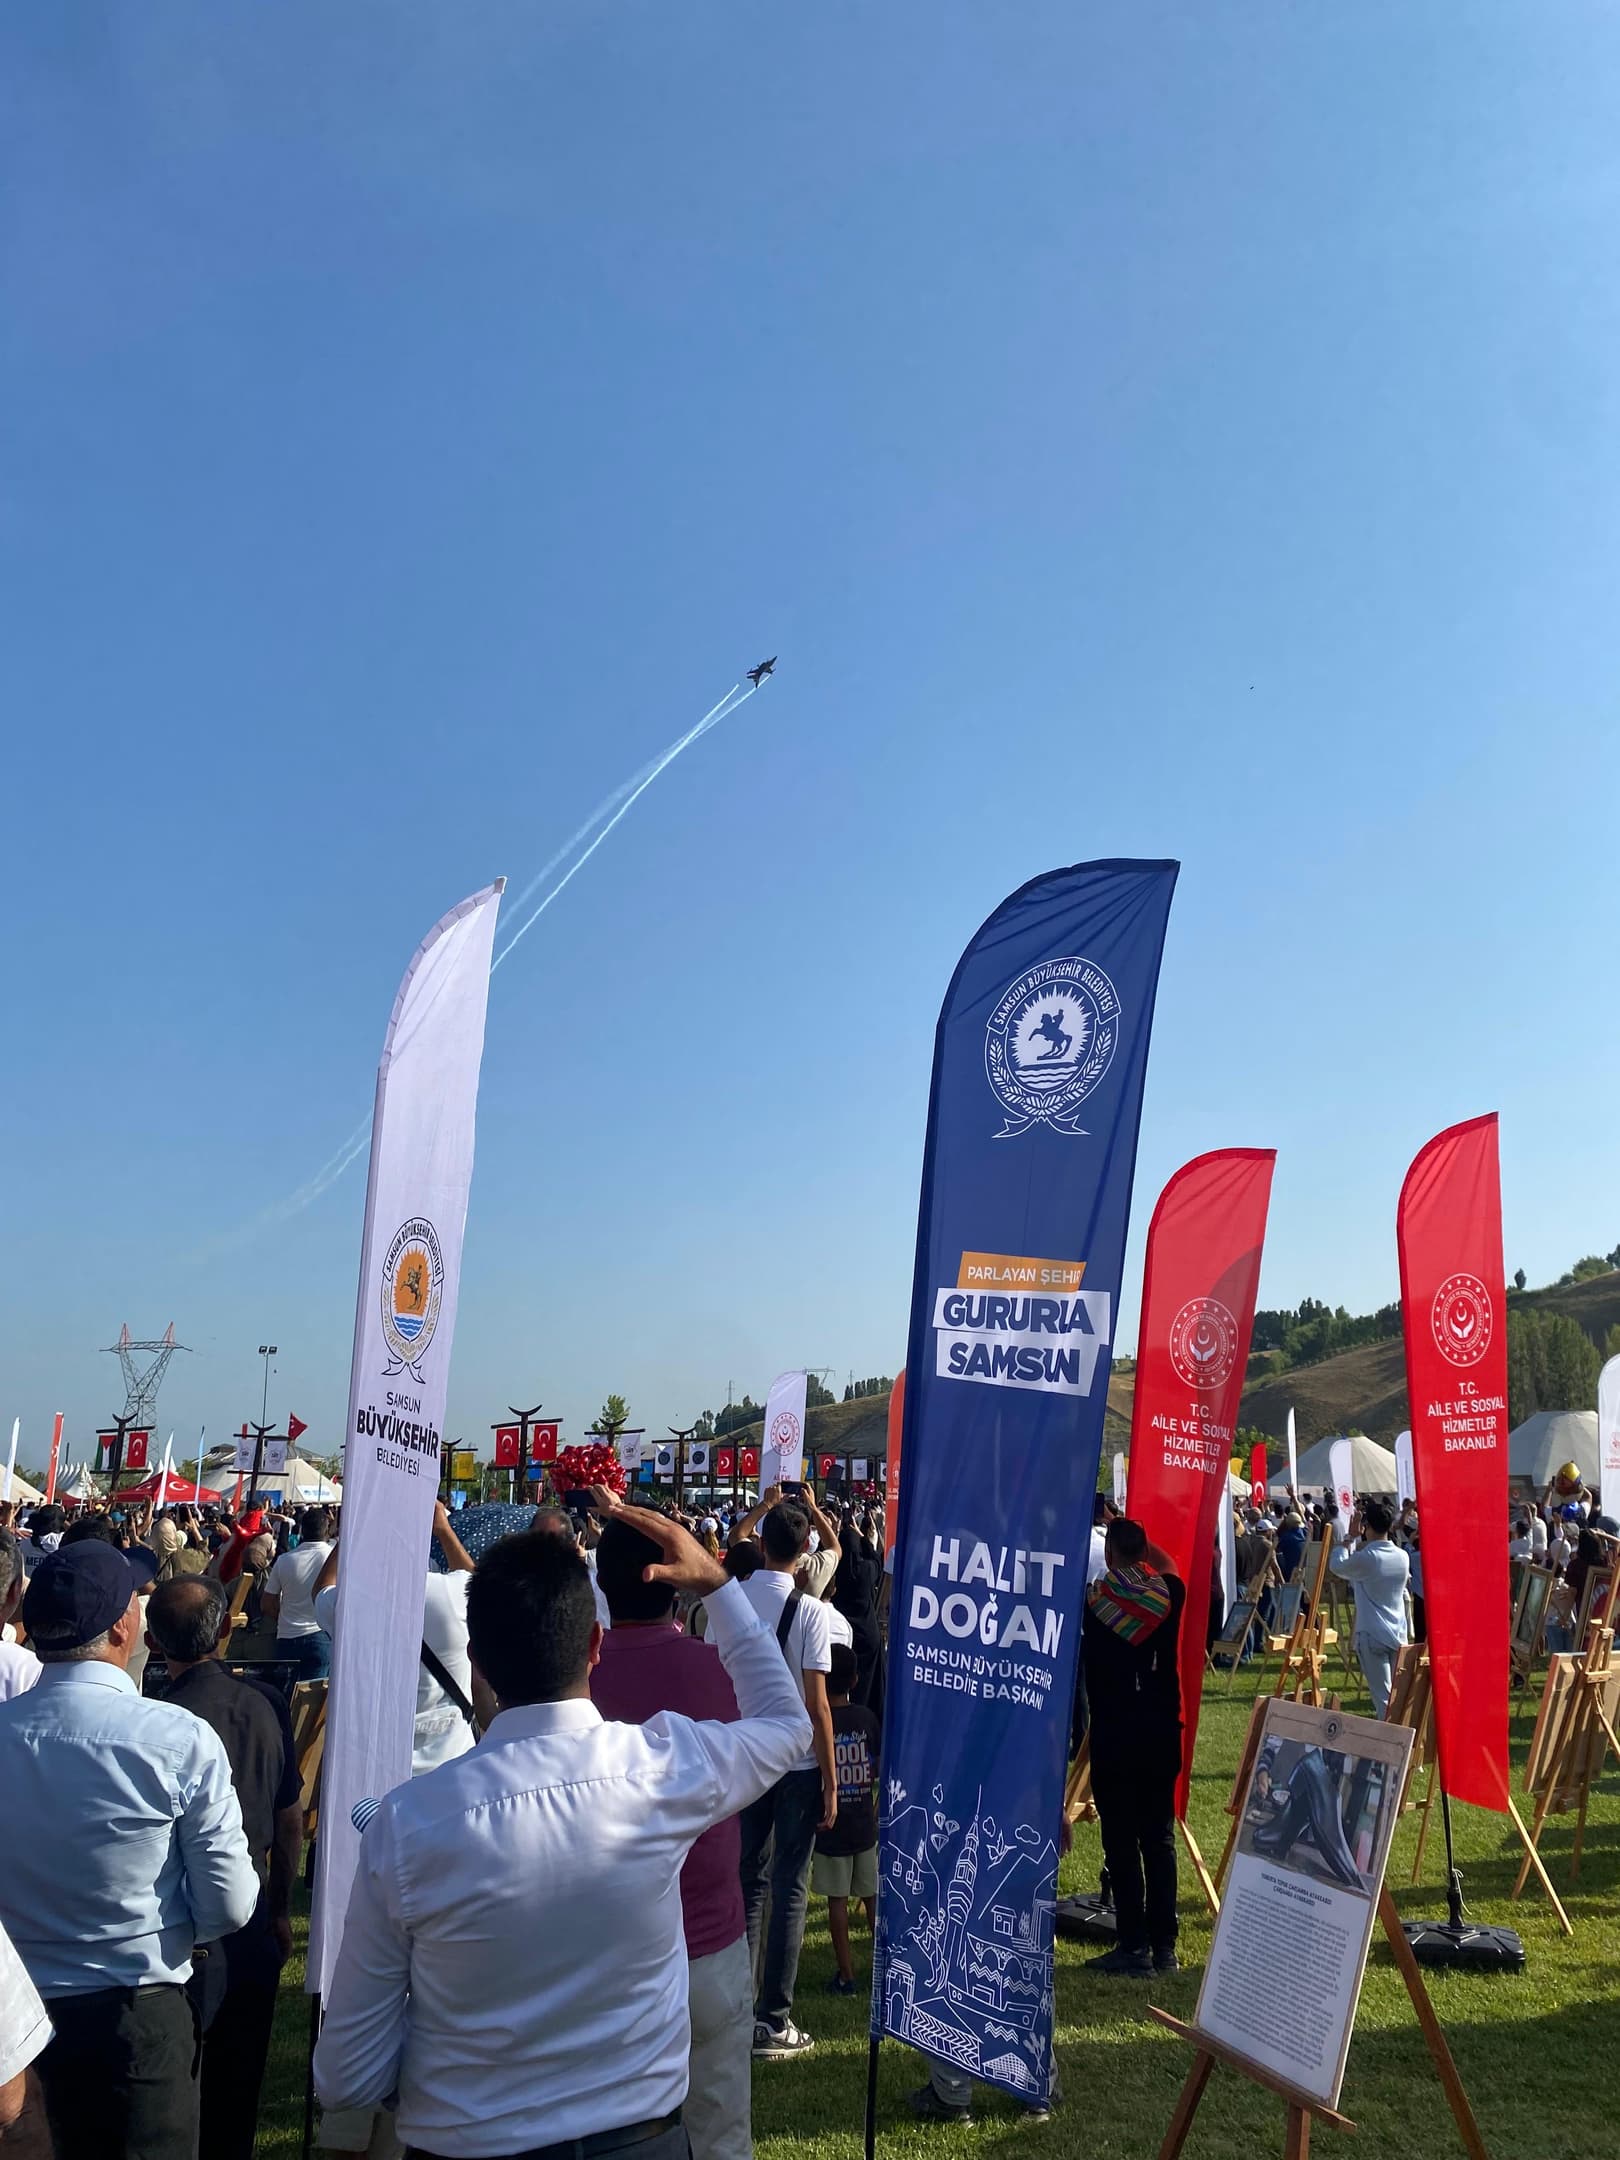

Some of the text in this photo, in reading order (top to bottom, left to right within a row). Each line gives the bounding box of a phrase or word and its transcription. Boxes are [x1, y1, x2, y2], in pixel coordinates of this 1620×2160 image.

[994, 984, 1027, 1025] SAMSUN
[1081, 968, 1117, 1014] BELEDİYESİ
[967, 1266, 1036, 1282] PARLAYAN
[942, 1294, 1095, 1335] GURURLA
[948, 1342, 1080, 1384] SAMSUN
[1458, 1381, 1480, 1395] T.C.
[386, 1391, 421, 1414] SAMSUN
[1190, 1403, 1213, 1419] T.C.
[1427, 1395, 1505, 1417] AİLE VE SOSYAL
[356, 1405, 439, 1459] BÜYÜKŞEHİR
[1151, 1413, 1177, 1431] AİLE
[1181, 1420, 1198, 1434] VE
[1442, 1416, 1497, 1434] HİZMETLER
[1163, 1433, 1221, 1457] HİZMETLER
[1444, 1432, 1497, 1452] BAKANLIĞI
[376, 1447, 420, 1477] BELEDİYESİ
[909, 1585, 1065, 1659] DOĞAN
[907, 1642, 972, 1671] SAMSUN
[982, 1683, 1045, 1711] BAŞKANI
[836, 1742, 869, 1764] OOL
